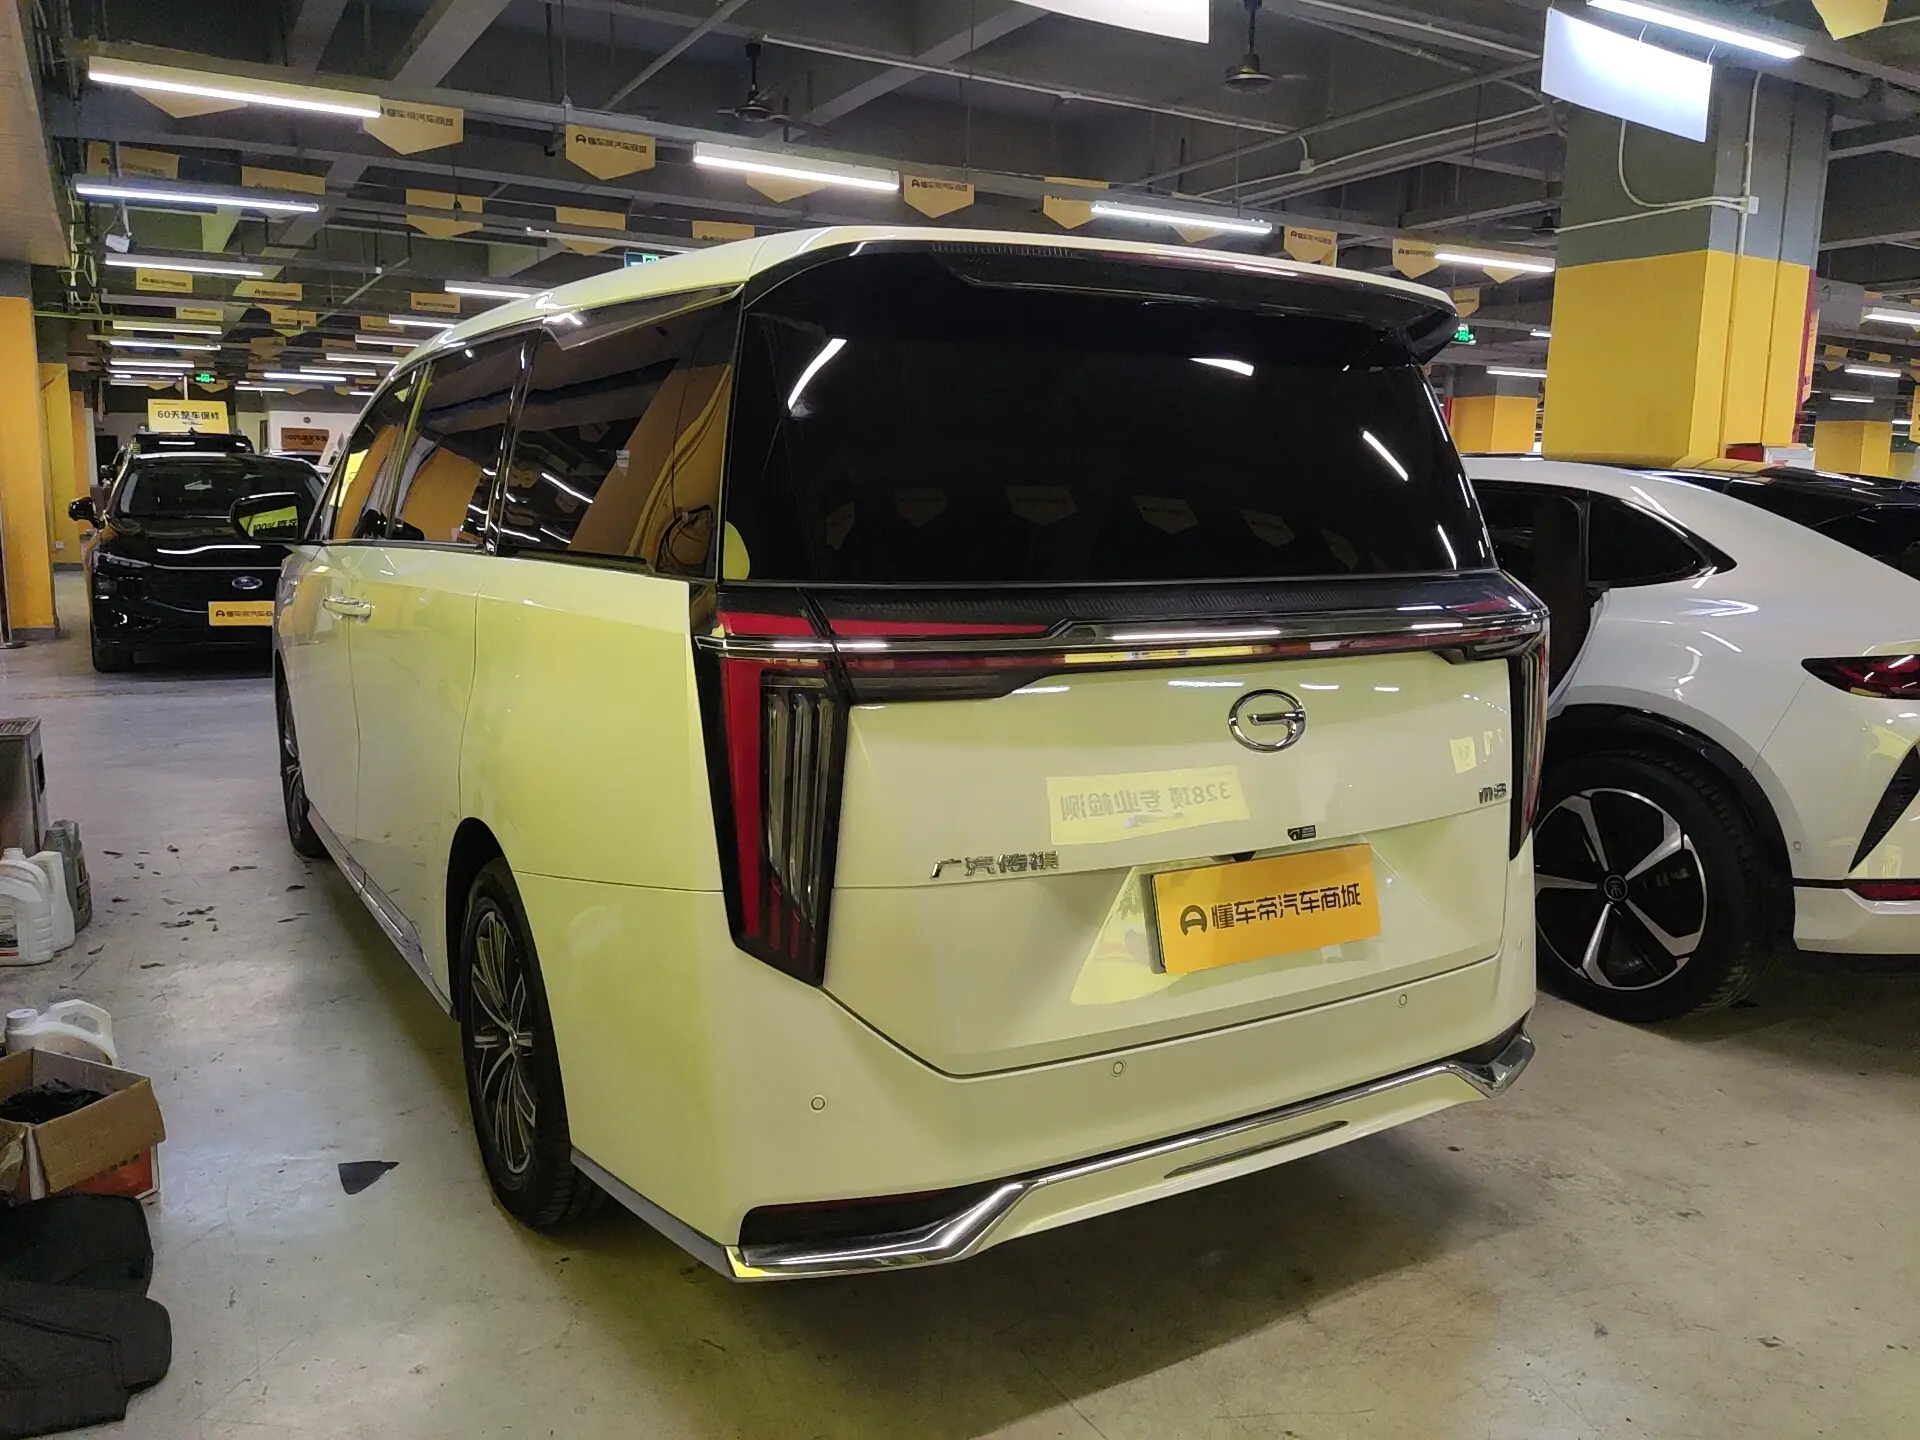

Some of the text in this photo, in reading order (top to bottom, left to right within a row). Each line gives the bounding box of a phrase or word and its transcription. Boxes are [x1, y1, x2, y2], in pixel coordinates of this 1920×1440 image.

[157, 410, 220, 420] 60天整车保修
[929, 850, 1060, 879] 广汽传祺
[1210, 882, 1362, 930] 懂车帝汽车商城
